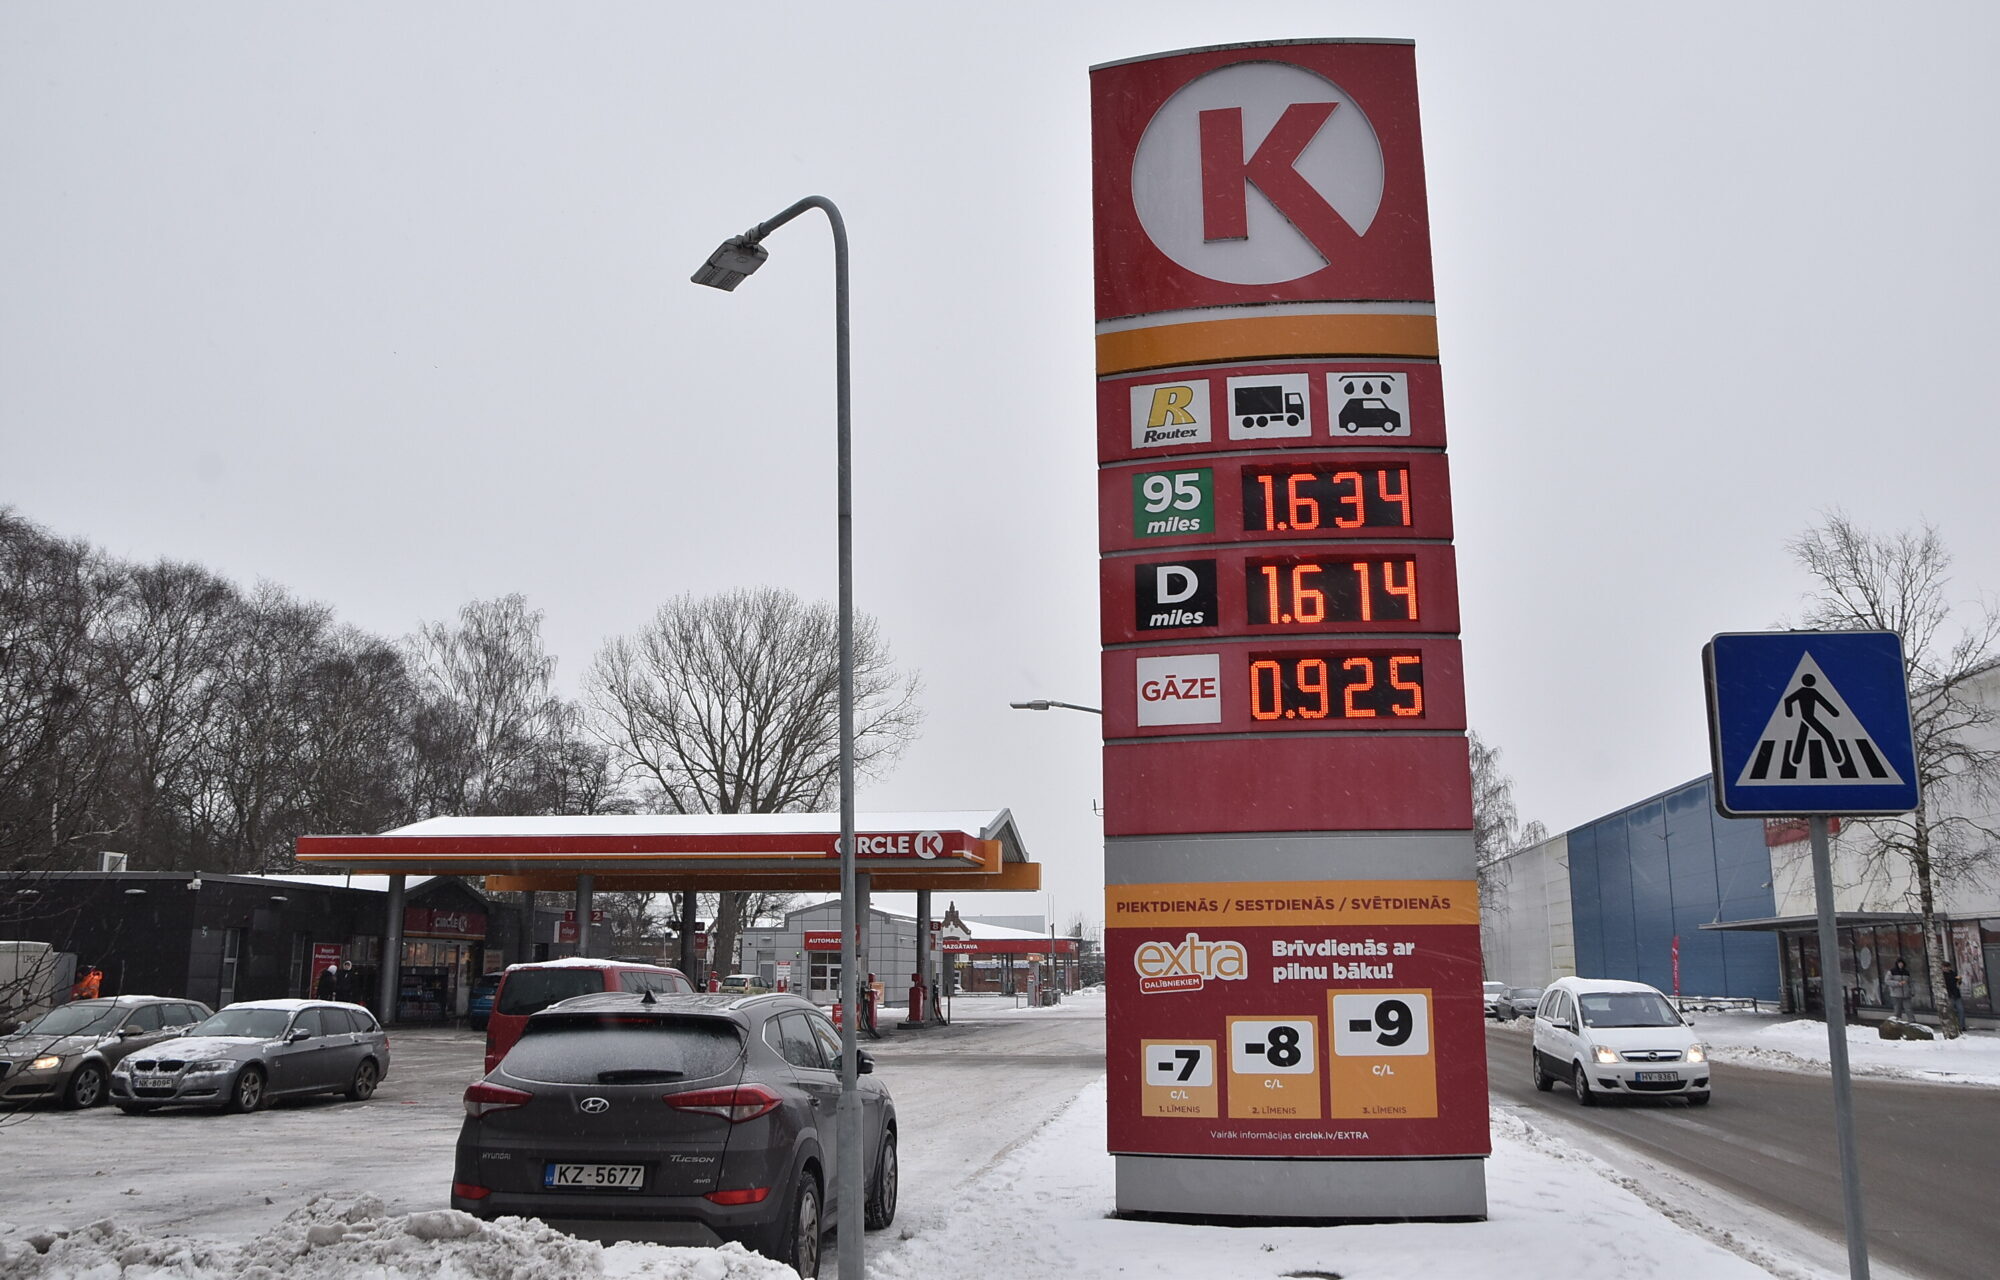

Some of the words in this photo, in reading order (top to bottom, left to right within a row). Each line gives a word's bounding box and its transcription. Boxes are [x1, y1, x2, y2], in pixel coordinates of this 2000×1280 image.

[1143, 428, 1198, 443] Routex
[1143, 472, 1201, 513] 95
[1257, 469, 1411, 531] 1.634
[1146, 516, 1200, 534] miles
[1157, 565, 1199, 604] D
[1262, 561, 1419, 624] 1.614
[1149, 610, 1204, 627] miles
[1141, 674, 1217, 702] GĀZE
[1250, 655, 1422, 720] 0.925
[1116, 898, 1219, 914] PIEKTDIENĀS
[1235, 896, 1335, 911] SESTDIENĀS
[1351, 895, 1452, 911] SVĒTDIENĀS
[1136, 935, 1246, 979] extra
[1272, 939, 1389, 958] Brīvdienās
[1392, 942, 1416, 957] ar
[1272, 962, 1327, 984] pilnu
[1333, 961, 1393, 980] bāku!
[1144, 976, 1200, 989] DALĪBNIEKIEM
[1349, 999, 1413, 1047] -9
[1245, 1026, 1302, 1068] -8
[1158, 1049, 1200, 1081] -7
[1372, 1064, 1394, 1076] C/L
[1264, 1078, 1283, 1089] C/L
[1167, 1104, 1200, 1113] LĪMENIS
[1262, 1105, 1296, 1115] LĪMENIS
[1372, 1104, 1407, 1115] LĪMENIS
[1210, 1130, 1238, 1140] Vairāk
[1240, 1130, 1292, 1142] informācijas
[1294, 1130, 1369, 1141] circlek.lv/EXTRA
[670, 1154, 715, 1163] TUCSON
